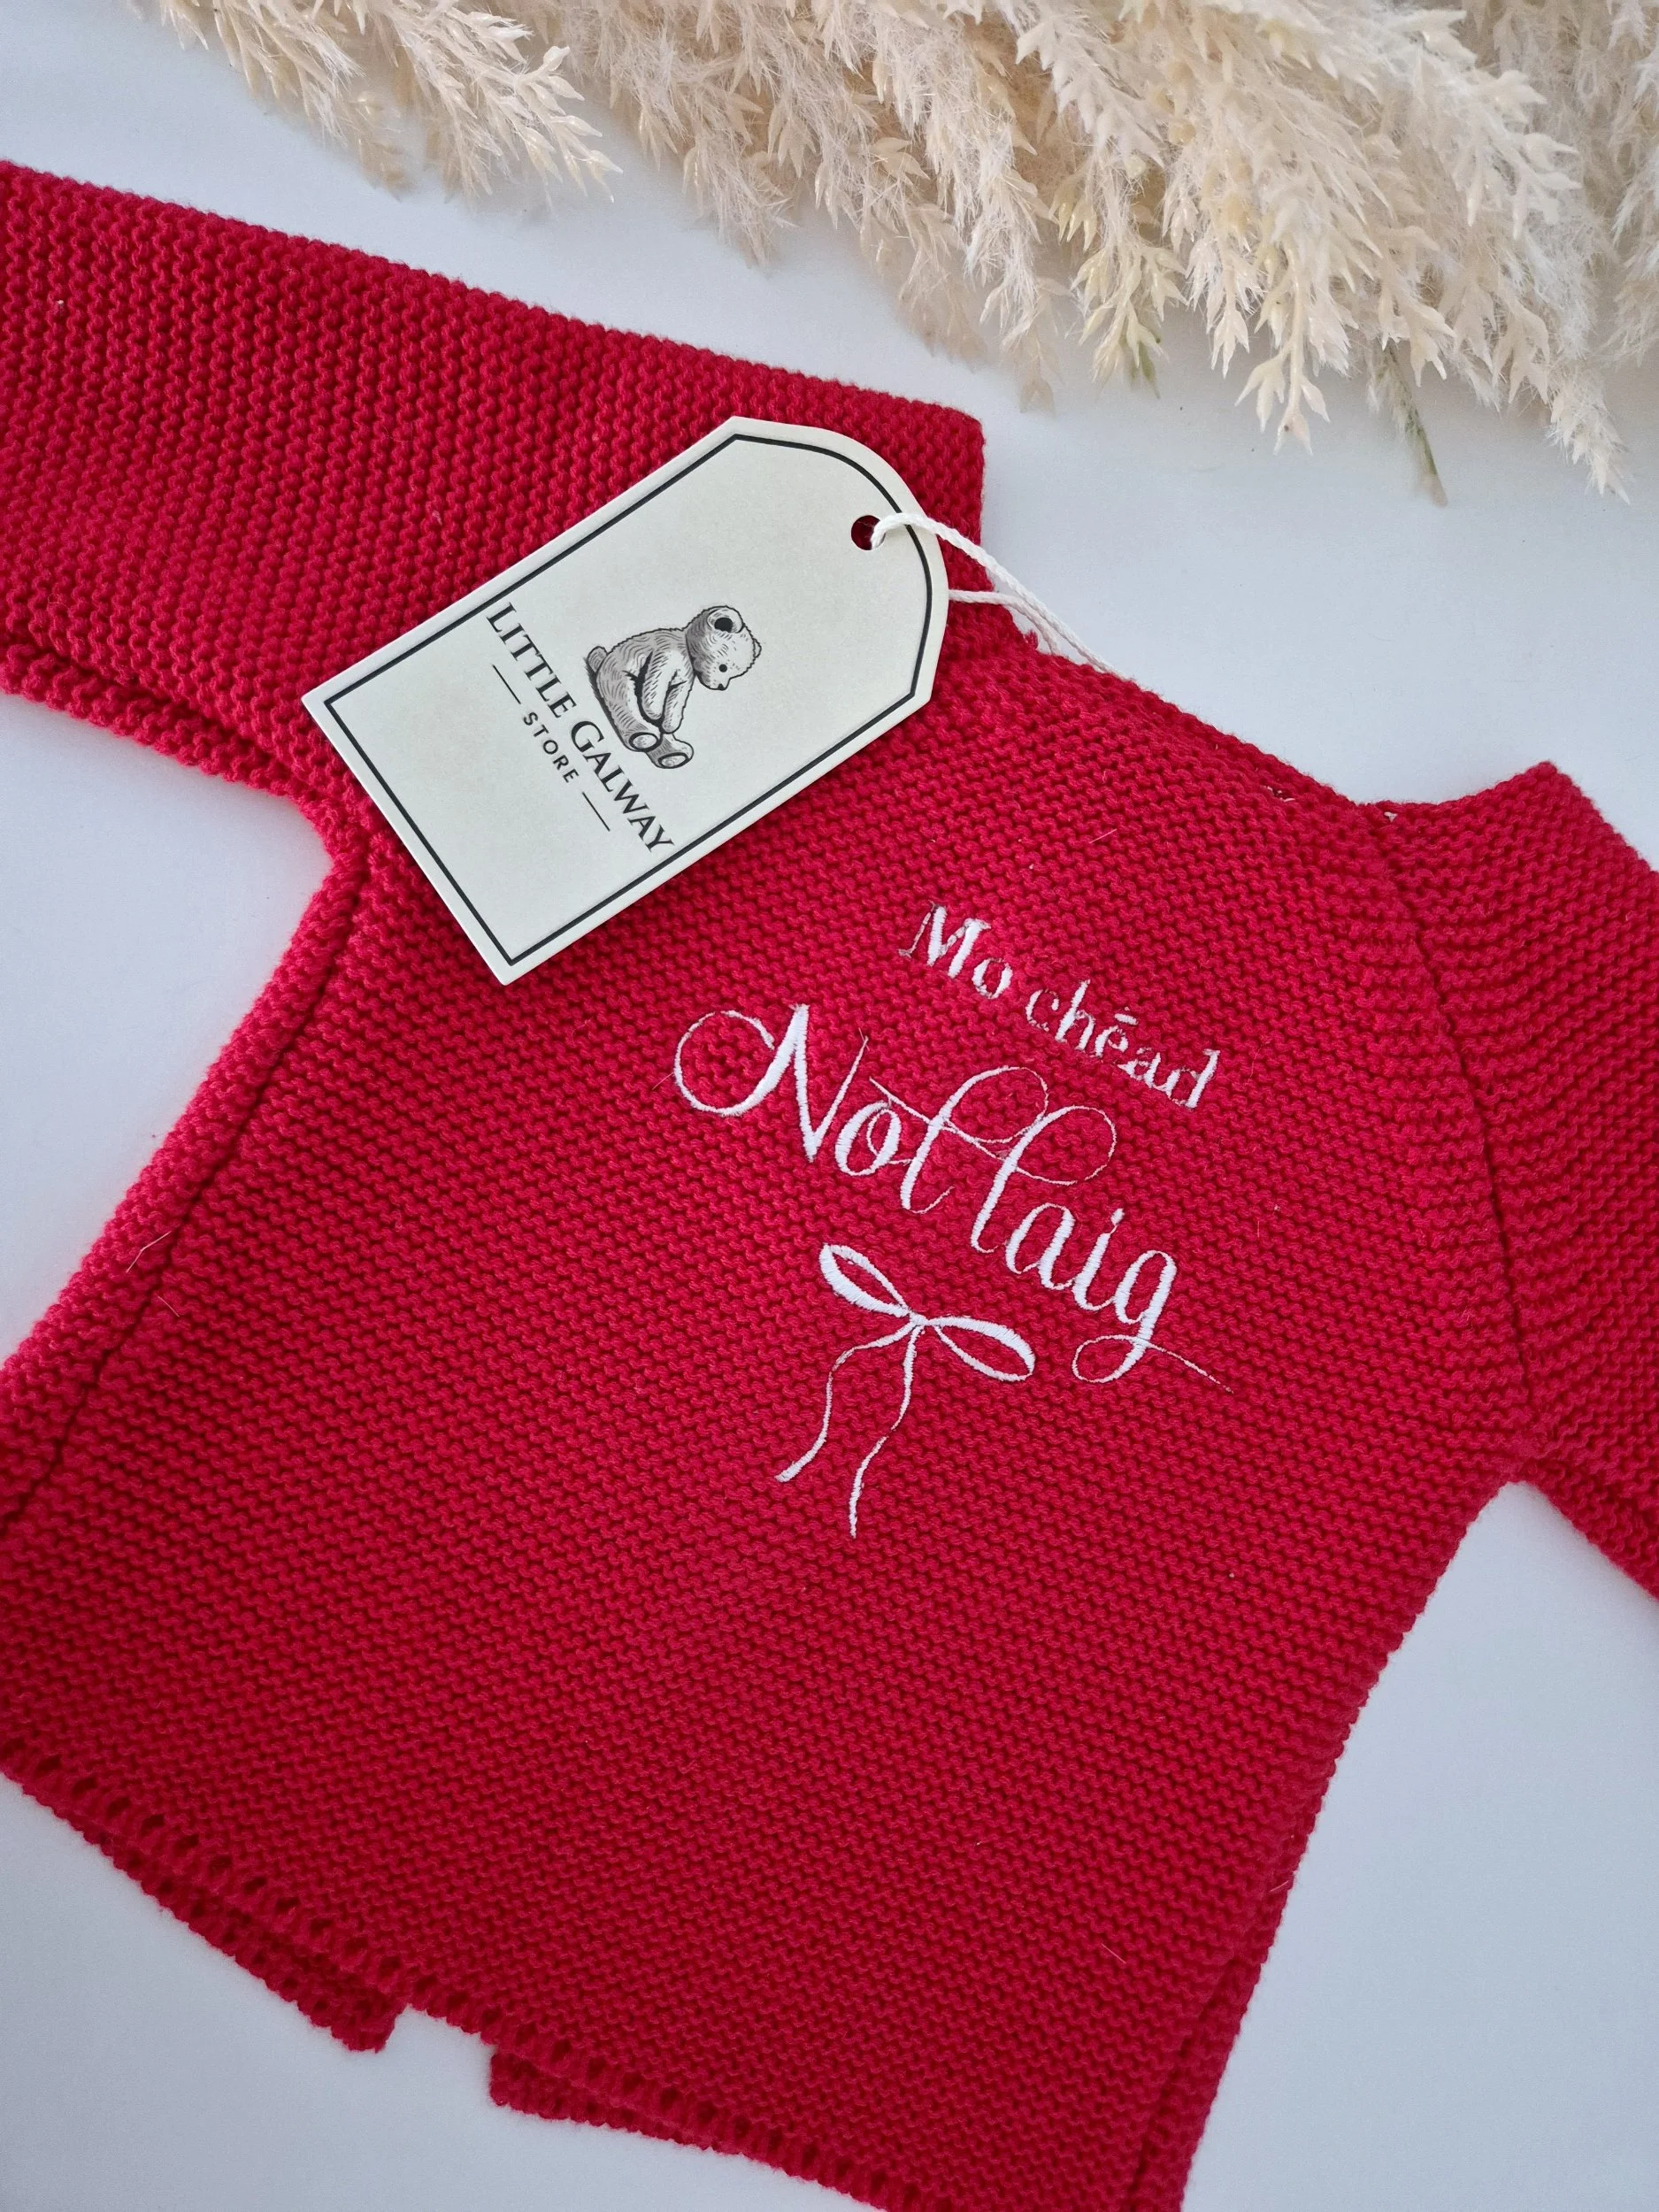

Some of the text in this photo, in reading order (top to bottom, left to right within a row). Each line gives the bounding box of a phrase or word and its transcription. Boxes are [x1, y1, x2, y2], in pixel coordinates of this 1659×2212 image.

[487, 602, 674, 852] LITTLE GALWAY
[523, 711, 580, 783] STORE
[898, 901, 1013, 1000] Mo
